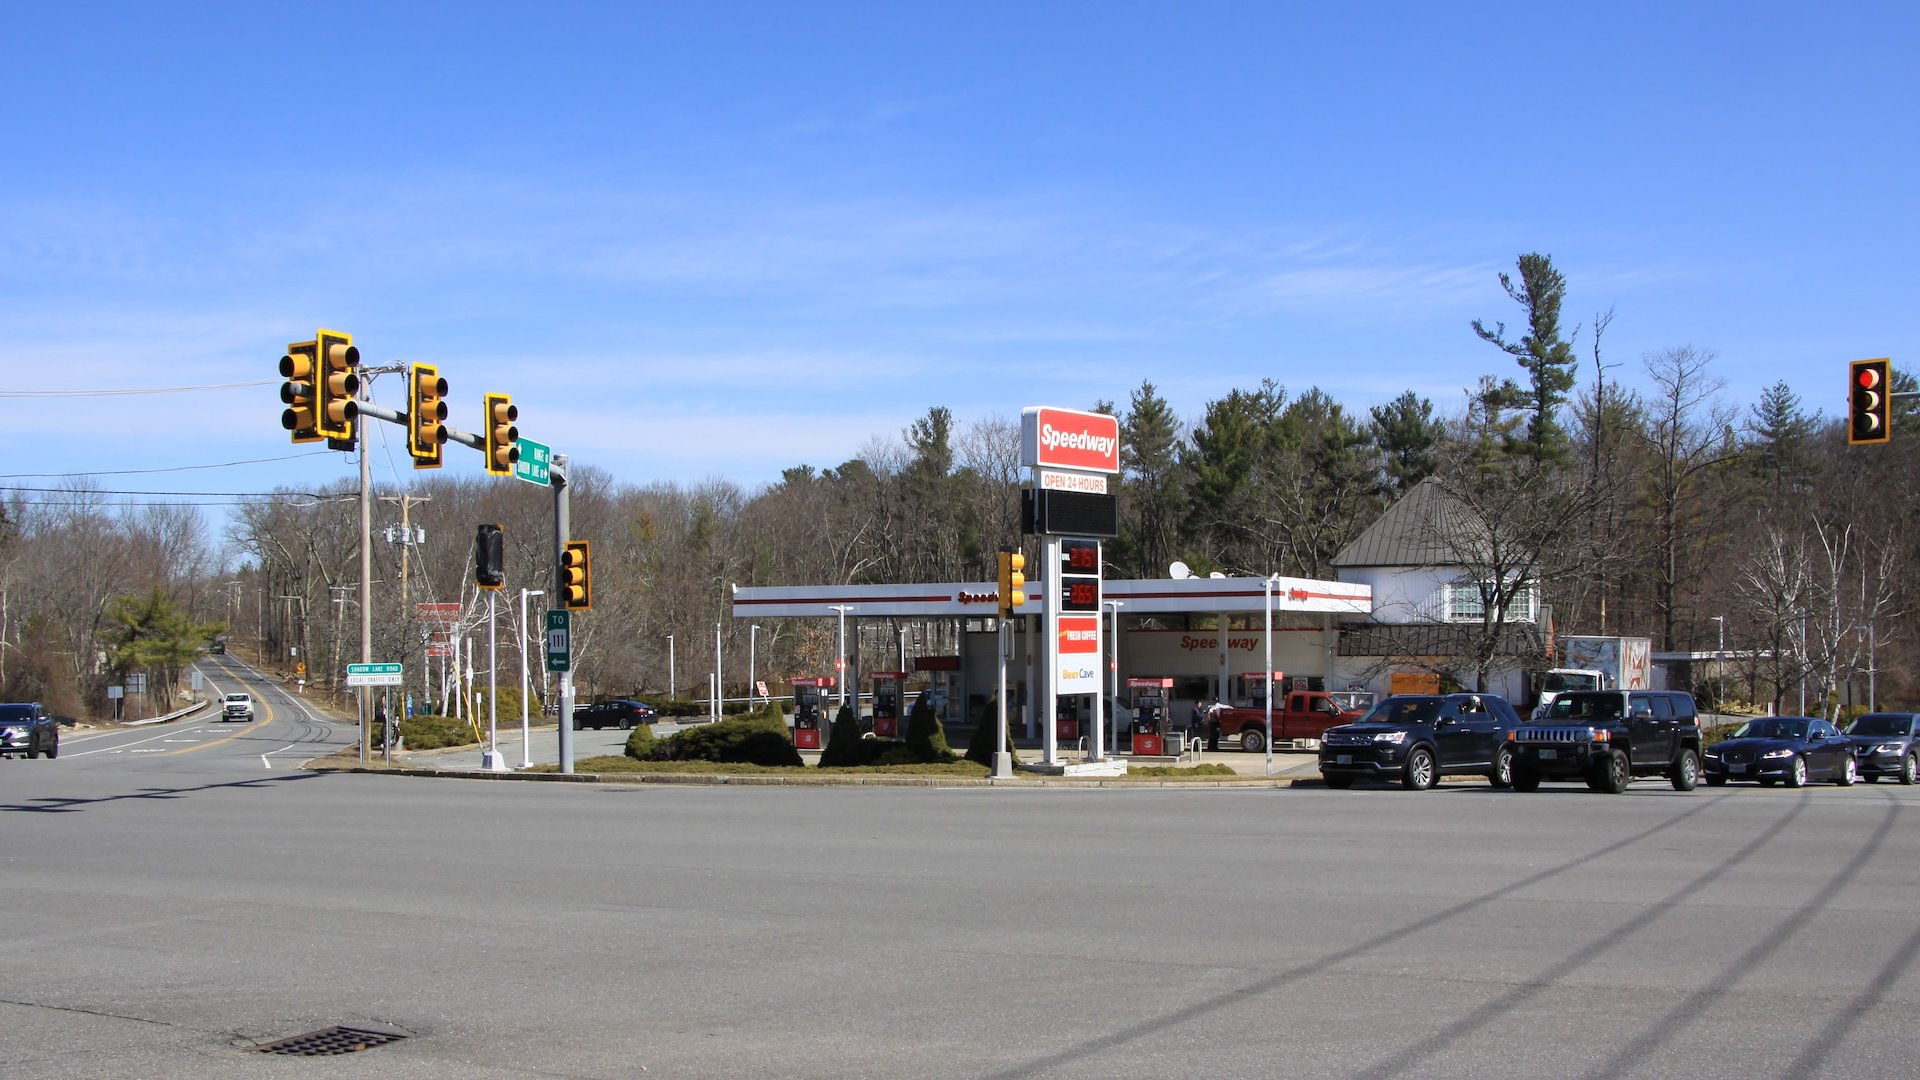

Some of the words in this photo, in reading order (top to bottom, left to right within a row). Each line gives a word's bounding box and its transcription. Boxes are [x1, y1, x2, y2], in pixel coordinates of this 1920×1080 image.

[1041, 423, 1115, 458] Speedway
[1044, 474, 1065, 488] OPEN
[1067, 476, 1077, 489] 24
[1078, 477, 1104, 492] HOURS
[552, 615, 564, 624] TO
[553, 634, 564, 647] 111
[1067, 630, 1081, 641] FRESH
[1081, 630, 1097, 641] COFFEE
[1180, 635, 1259, 652] Speeway
[1062, 669, 1079, 680] Beer
[1079, 668, 1094, 679] Cave
[1143, 740, 1153, 749] S
